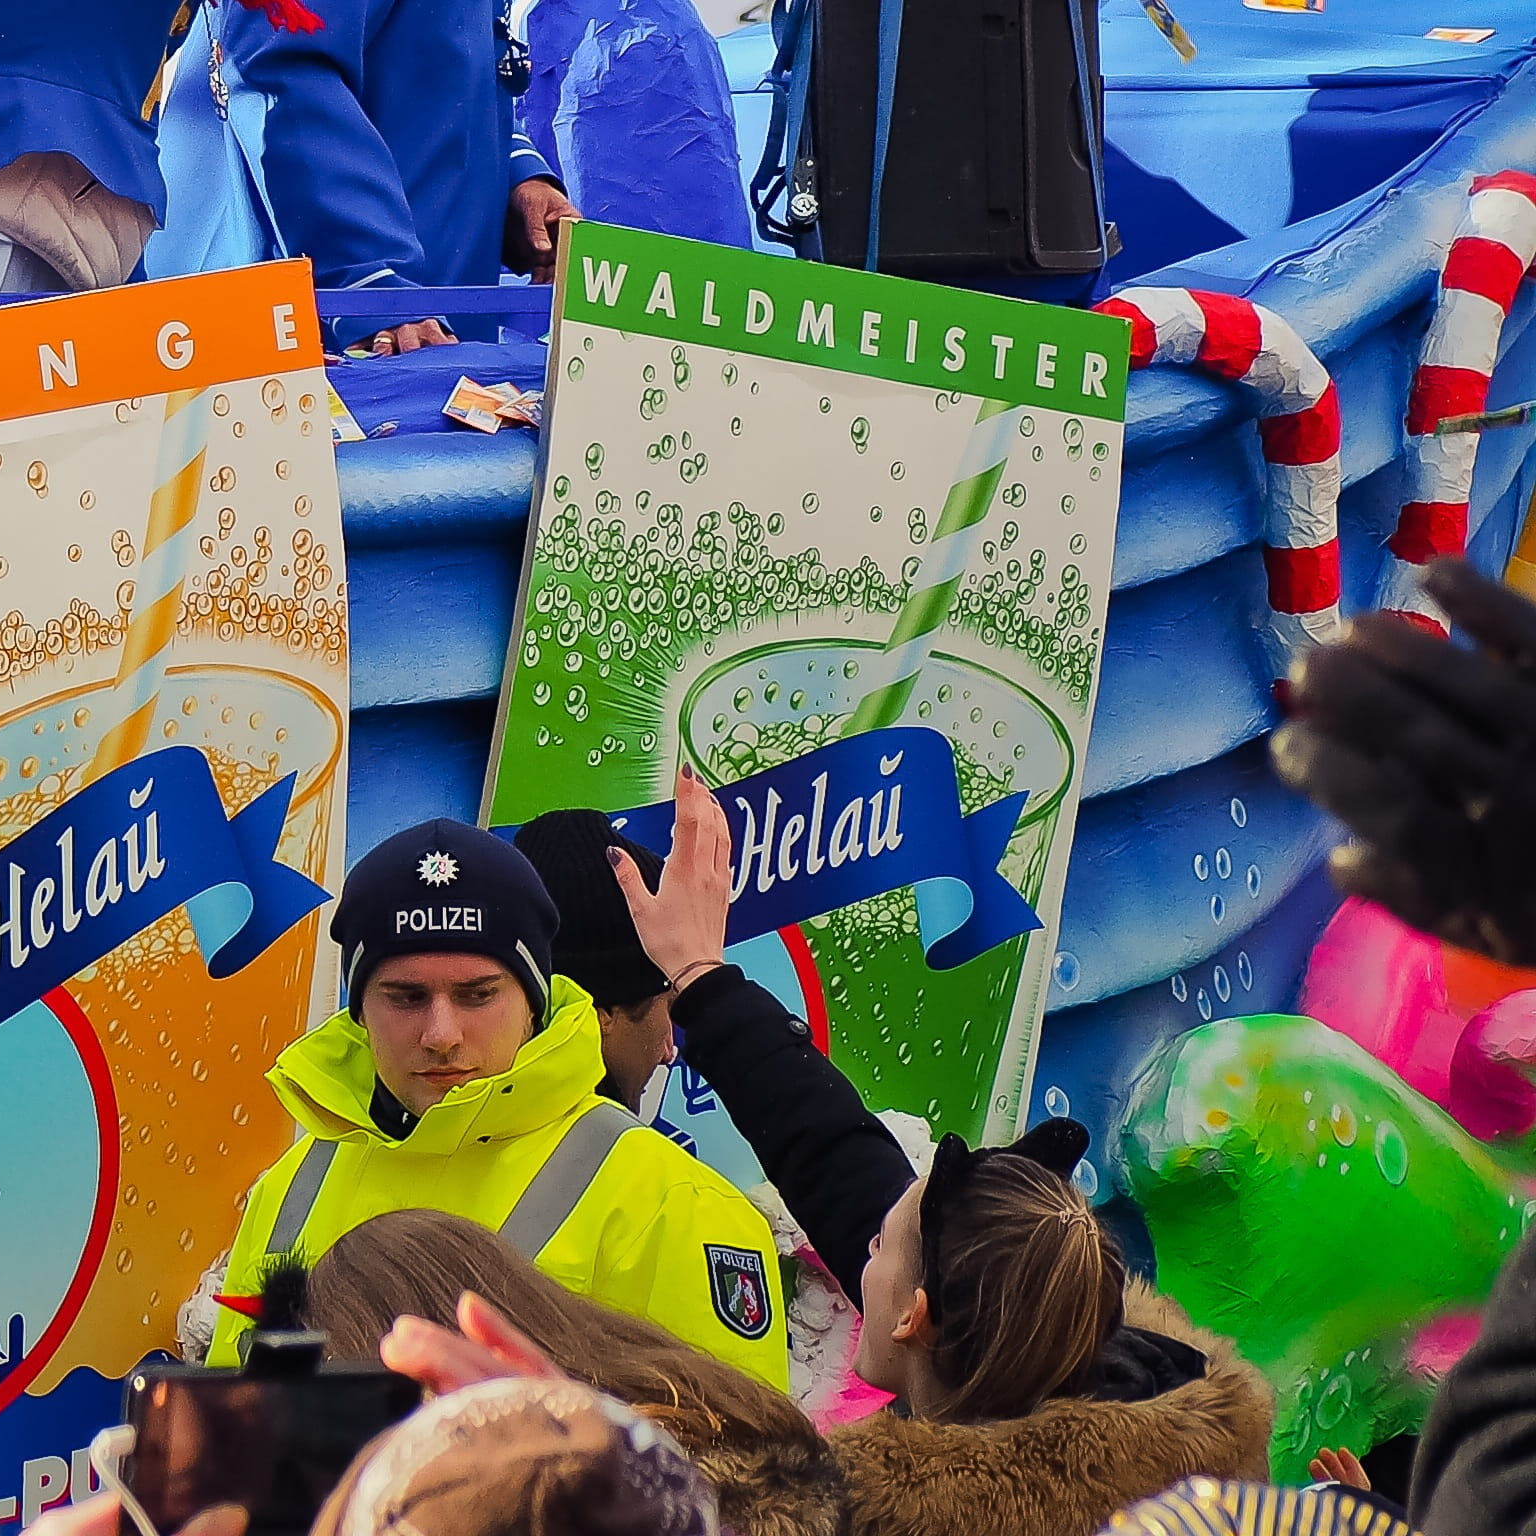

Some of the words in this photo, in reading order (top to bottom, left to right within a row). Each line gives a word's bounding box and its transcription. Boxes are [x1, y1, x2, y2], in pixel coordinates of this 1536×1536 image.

[581, 256, 1107, 399] WALDMEISTER
[395, 906, 482, 934] POLIZEI
[712, 1250, 760, 1272] POLIZEI
